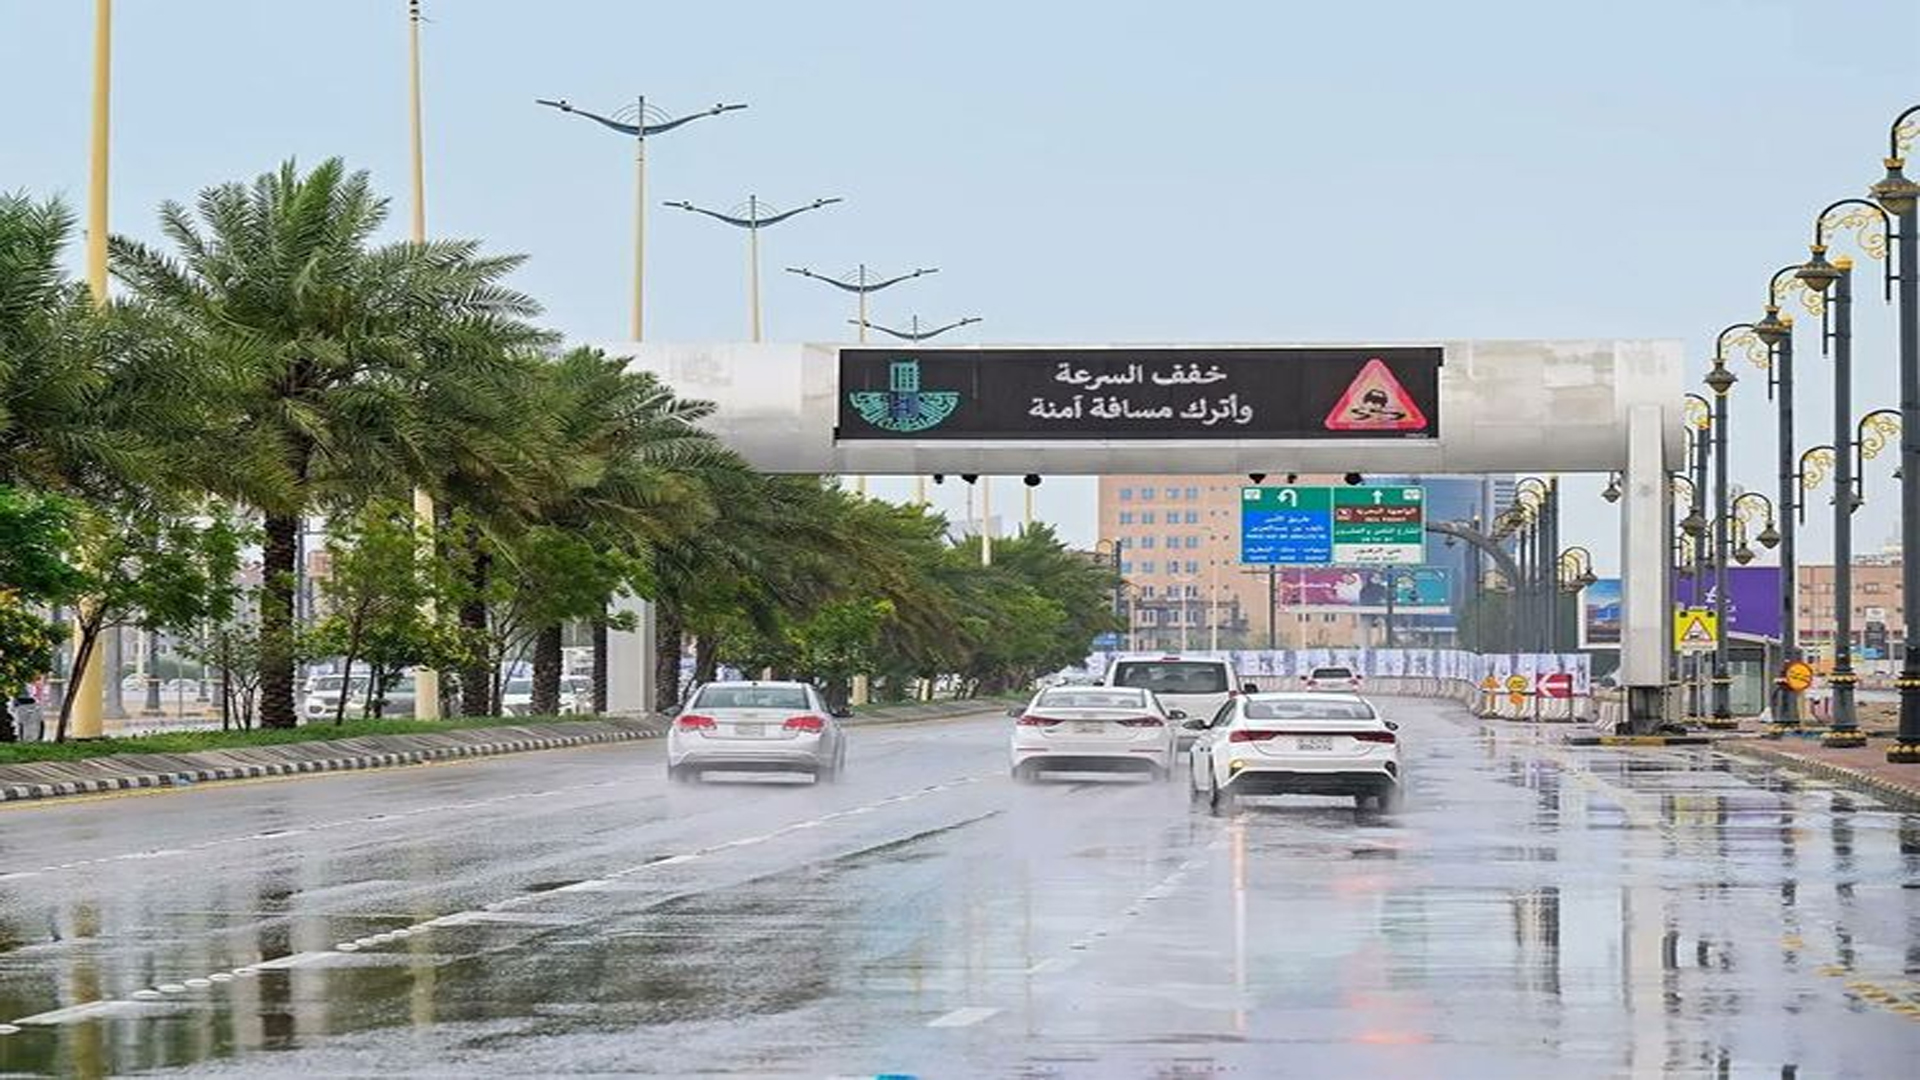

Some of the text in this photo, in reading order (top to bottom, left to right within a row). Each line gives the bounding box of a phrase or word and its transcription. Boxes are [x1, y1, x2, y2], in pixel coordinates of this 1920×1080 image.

[1054, 361, 1227, 390] خفف السرعة
[1028, 393, 1253, 425] وأترك مسافة آمنة
